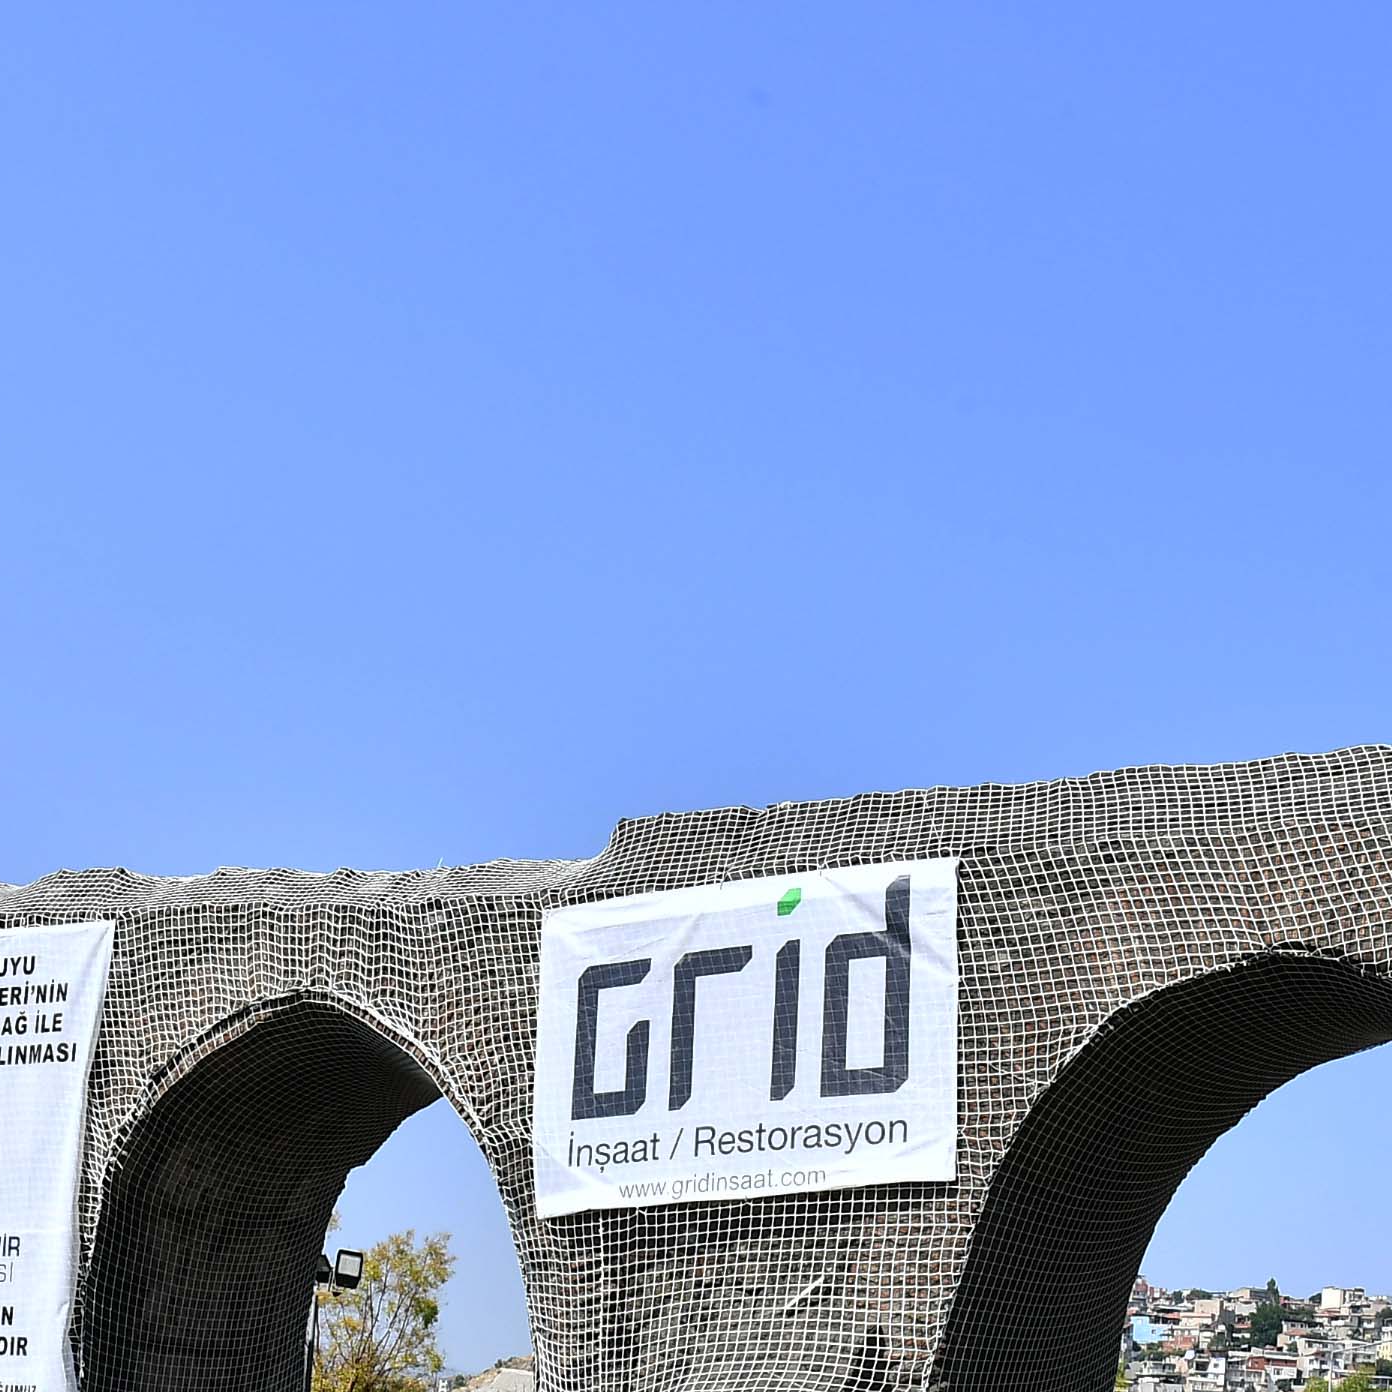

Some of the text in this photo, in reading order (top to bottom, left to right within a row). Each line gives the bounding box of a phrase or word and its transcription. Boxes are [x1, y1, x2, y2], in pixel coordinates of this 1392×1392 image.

[1, 1010, 28, 1036] AĞ
[34, 1010, 63, 1034] İLE
[568, 1119, 909, 1174] İnşaat / Restorasyon
[618, 1168, 827, 1200] www.gridinsaat.com
